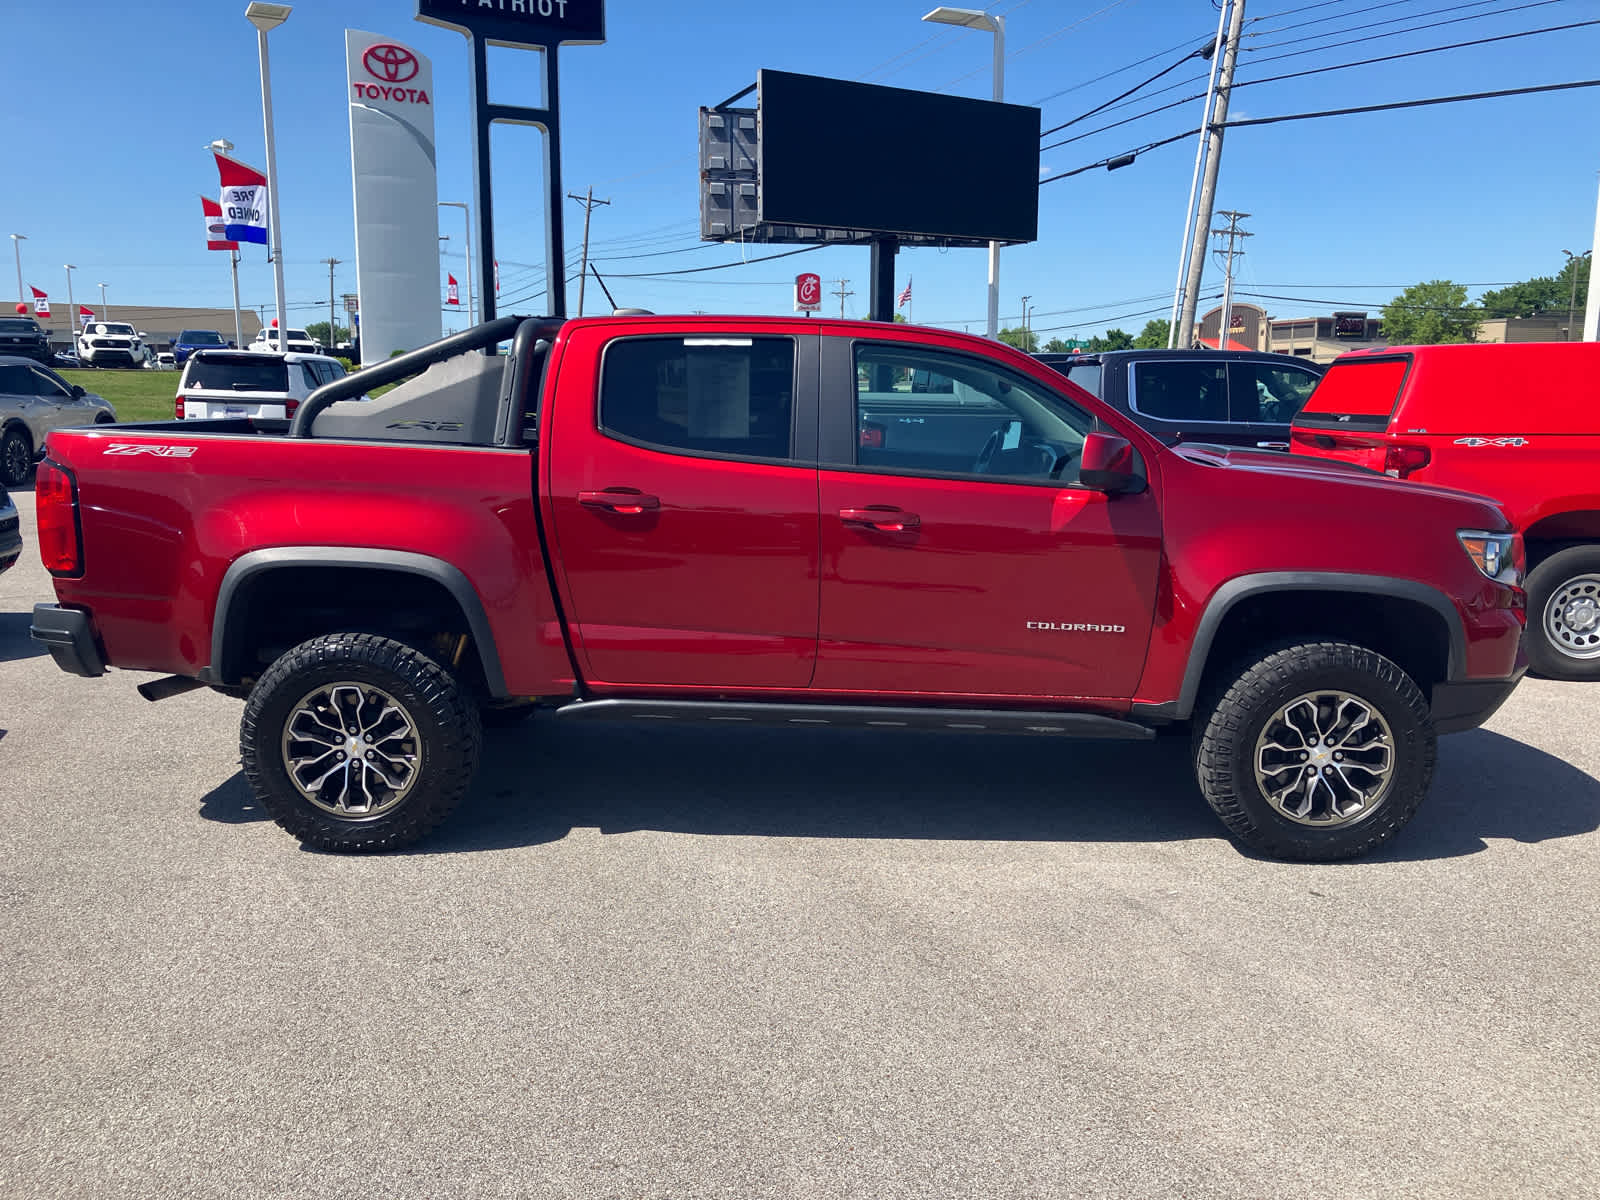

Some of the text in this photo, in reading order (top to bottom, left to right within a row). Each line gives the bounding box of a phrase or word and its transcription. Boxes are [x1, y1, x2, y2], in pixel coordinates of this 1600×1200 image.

[462, 0, 568, 18] ATRIOT
[353, 82, 430, 105] TOYOTA
[103, 443, 198, 458] ZR2
[1026, 621, 1126, 633] COLORADO
